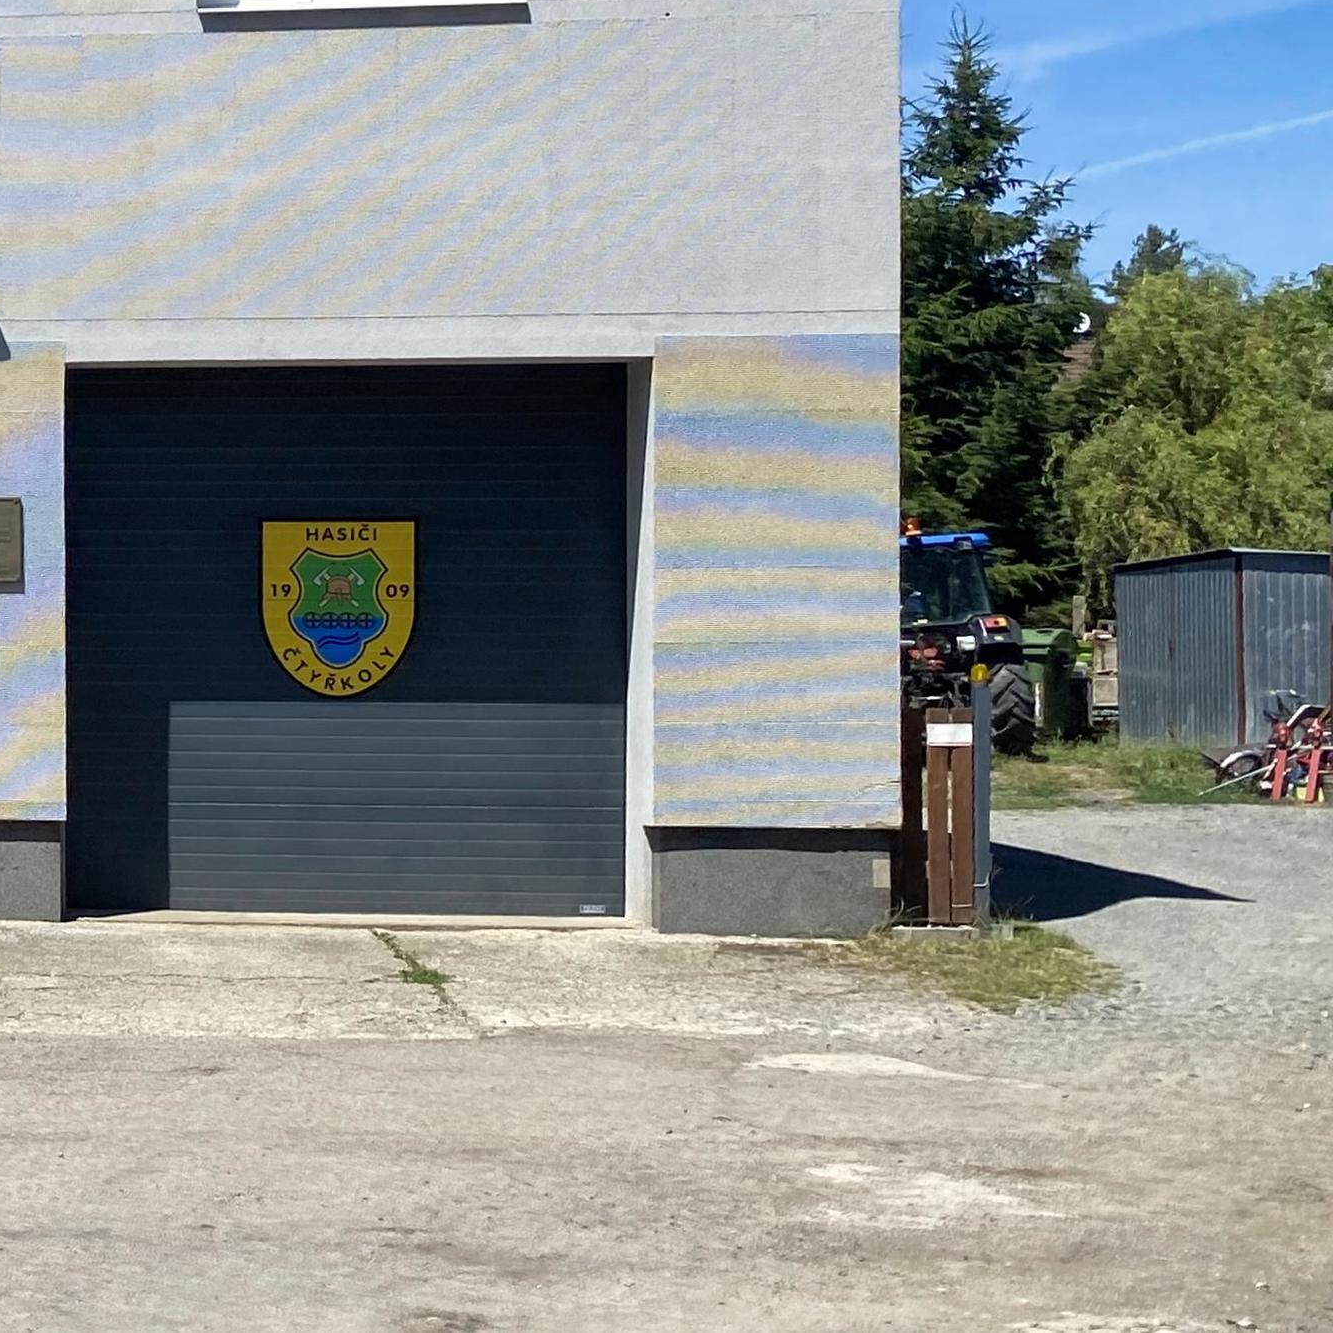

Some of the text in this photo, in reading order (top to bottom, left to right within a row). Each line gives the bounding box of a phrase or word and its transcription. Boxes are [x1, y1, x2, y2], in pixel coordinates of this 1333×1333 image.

[306, 524, 378, 541] HASIČI
[270, 583, 409, 598] 19 09
[283, 646, 395, 691] ČTYŘKOLY
